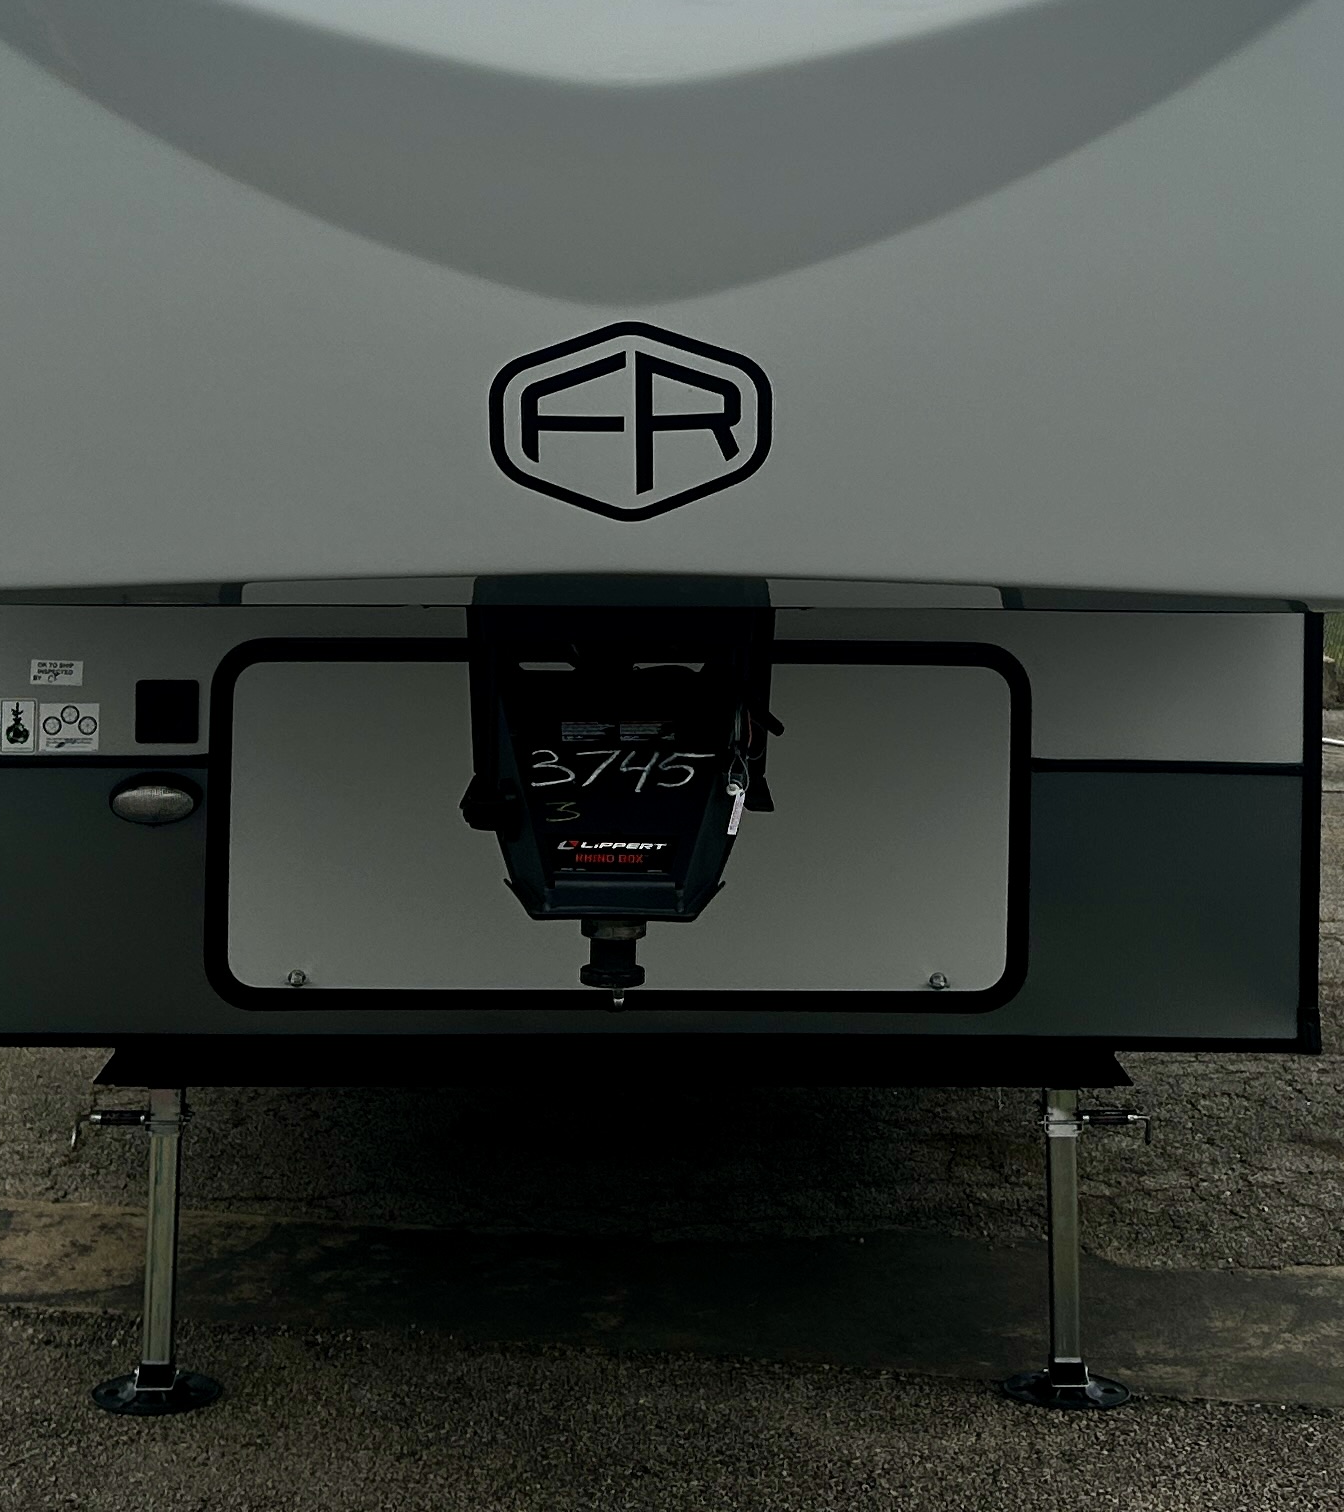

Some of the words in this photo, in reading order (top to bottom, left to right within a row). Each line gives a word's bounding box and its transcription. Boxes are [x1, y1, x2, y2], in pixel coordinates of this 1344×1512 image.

[531, 749, 715, 792] 3745
[580, 841, 668, 850] LIPPERT
[575, 853, 615, 864] RHINO
[618, 853, 644, 864] BOX
